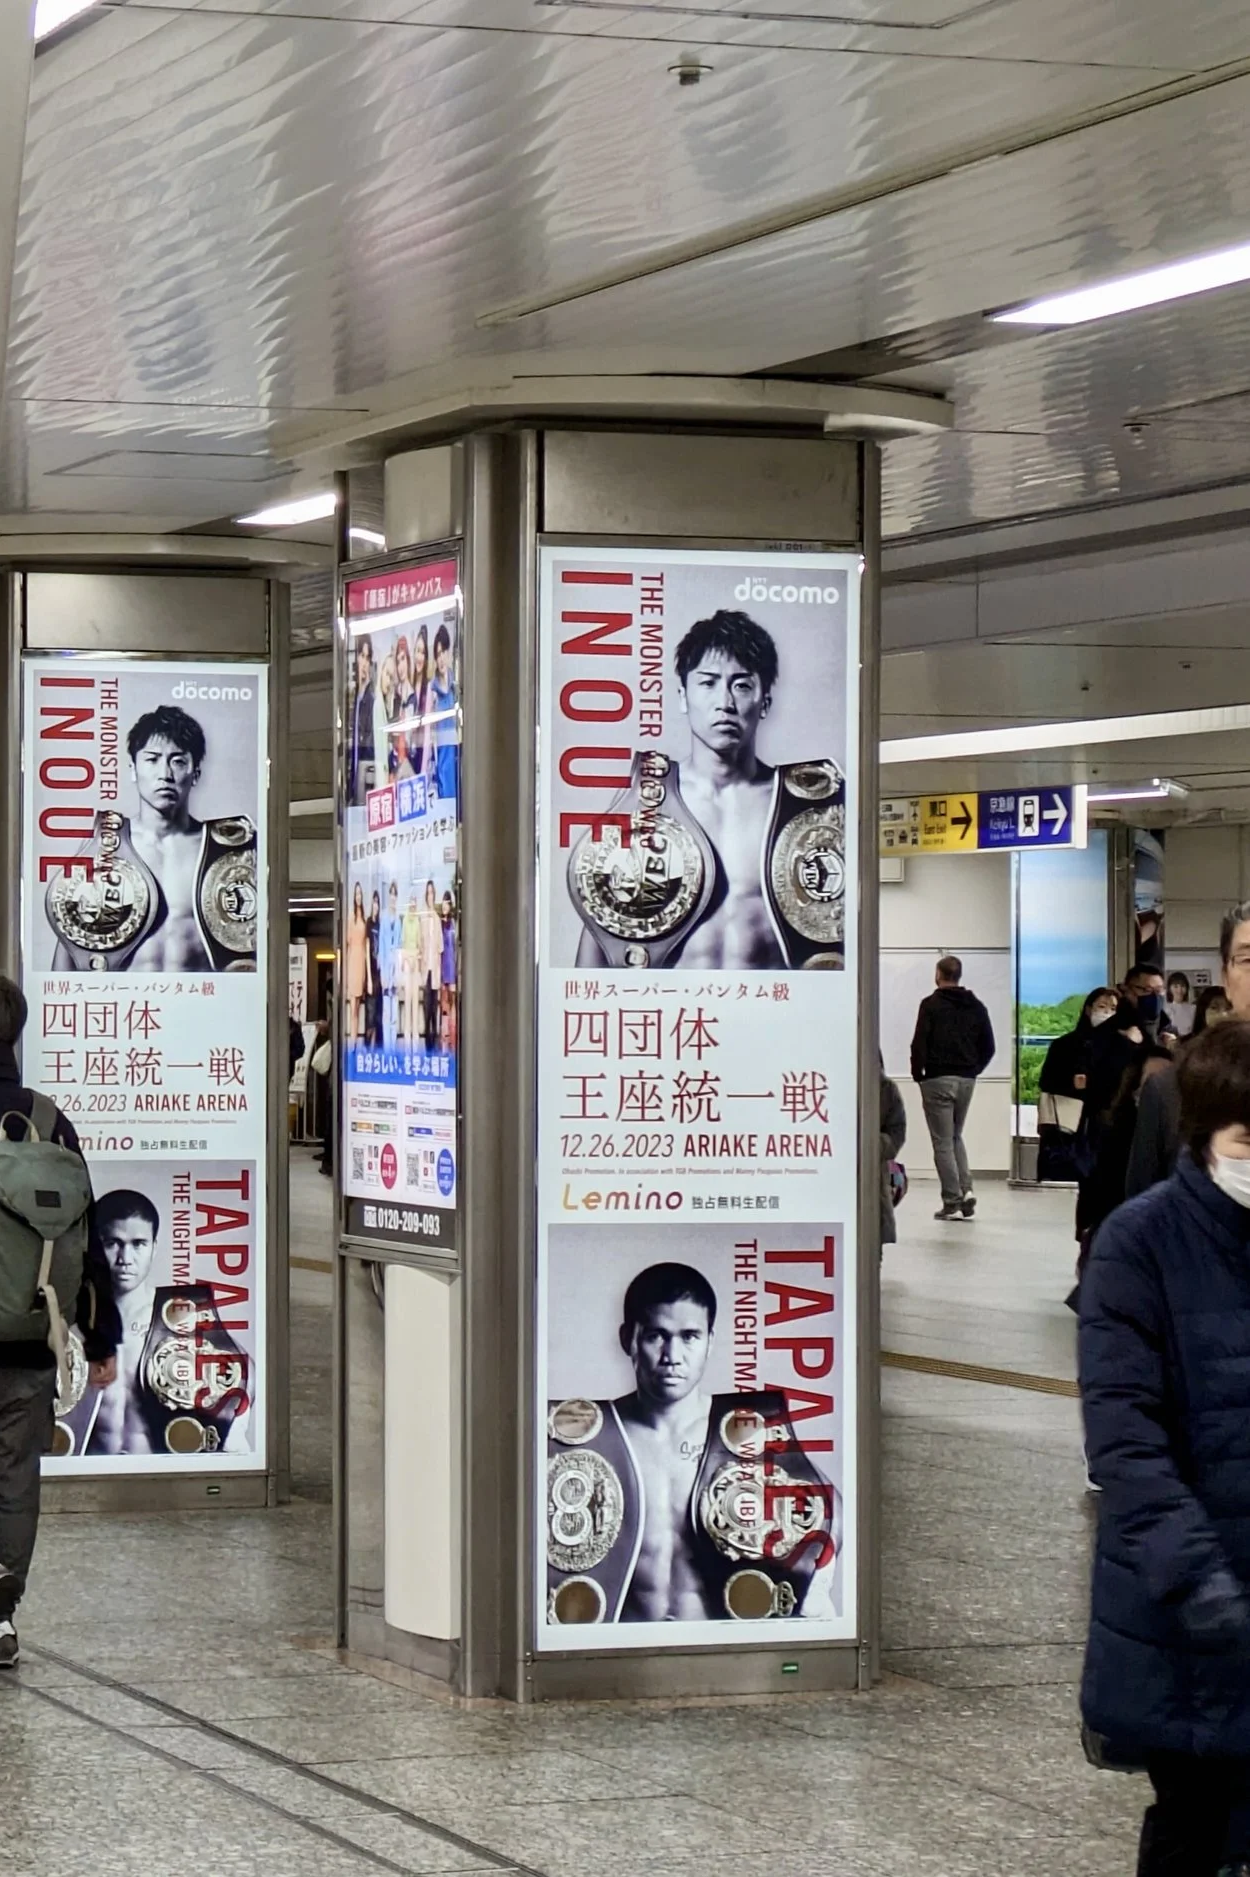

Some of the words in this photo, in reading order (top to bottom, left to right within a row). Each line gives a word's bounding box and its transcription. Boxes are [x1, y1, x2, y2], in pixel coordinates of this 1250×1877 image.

[640, 572, 664, 616] THE
[734, 578, 840, 604] docomo
[101, 678, 118, 711] THE
[172, 681, 252, 701] docomo
[639, 624, 664, 737] MONSTER
[559, 570, 633, 849] INOUE
[100, 717, 118, 800] MONSTER
[38, 677, 95, 884] INOUE
[564, 980, 790, 1002] 世界スーパー・バンタム級
[42, 1000, 162, 1040] 四団体
[563, 1006, 720, 1061] 四団体
[39, 1046, 246, 1087] 王座統一戦
[134, 1094, 191, 1112] ARIAKE
[196, 1094, 249, 1112] ARENA
[560, 1069, 830, 1124] 王座統一戦
[78, 1130, 134, 1151] mino
[560, 1133, 674, 1158] 12.26.2023
[683, 1134, 758, 1157] ARIAKE
[765, 1134, 833, 1158] ARENA
[172, 1172, 191, 1205] THE
[562, 1182, 683, 1210] Lemino
[377, 1207, 440, 1236] 0120-209-093
[734, 1239, 757, 1282] THE
[194, 1169, 250, 1418] TAPALES
[763, 1236, 835, 1570] TAPALES
